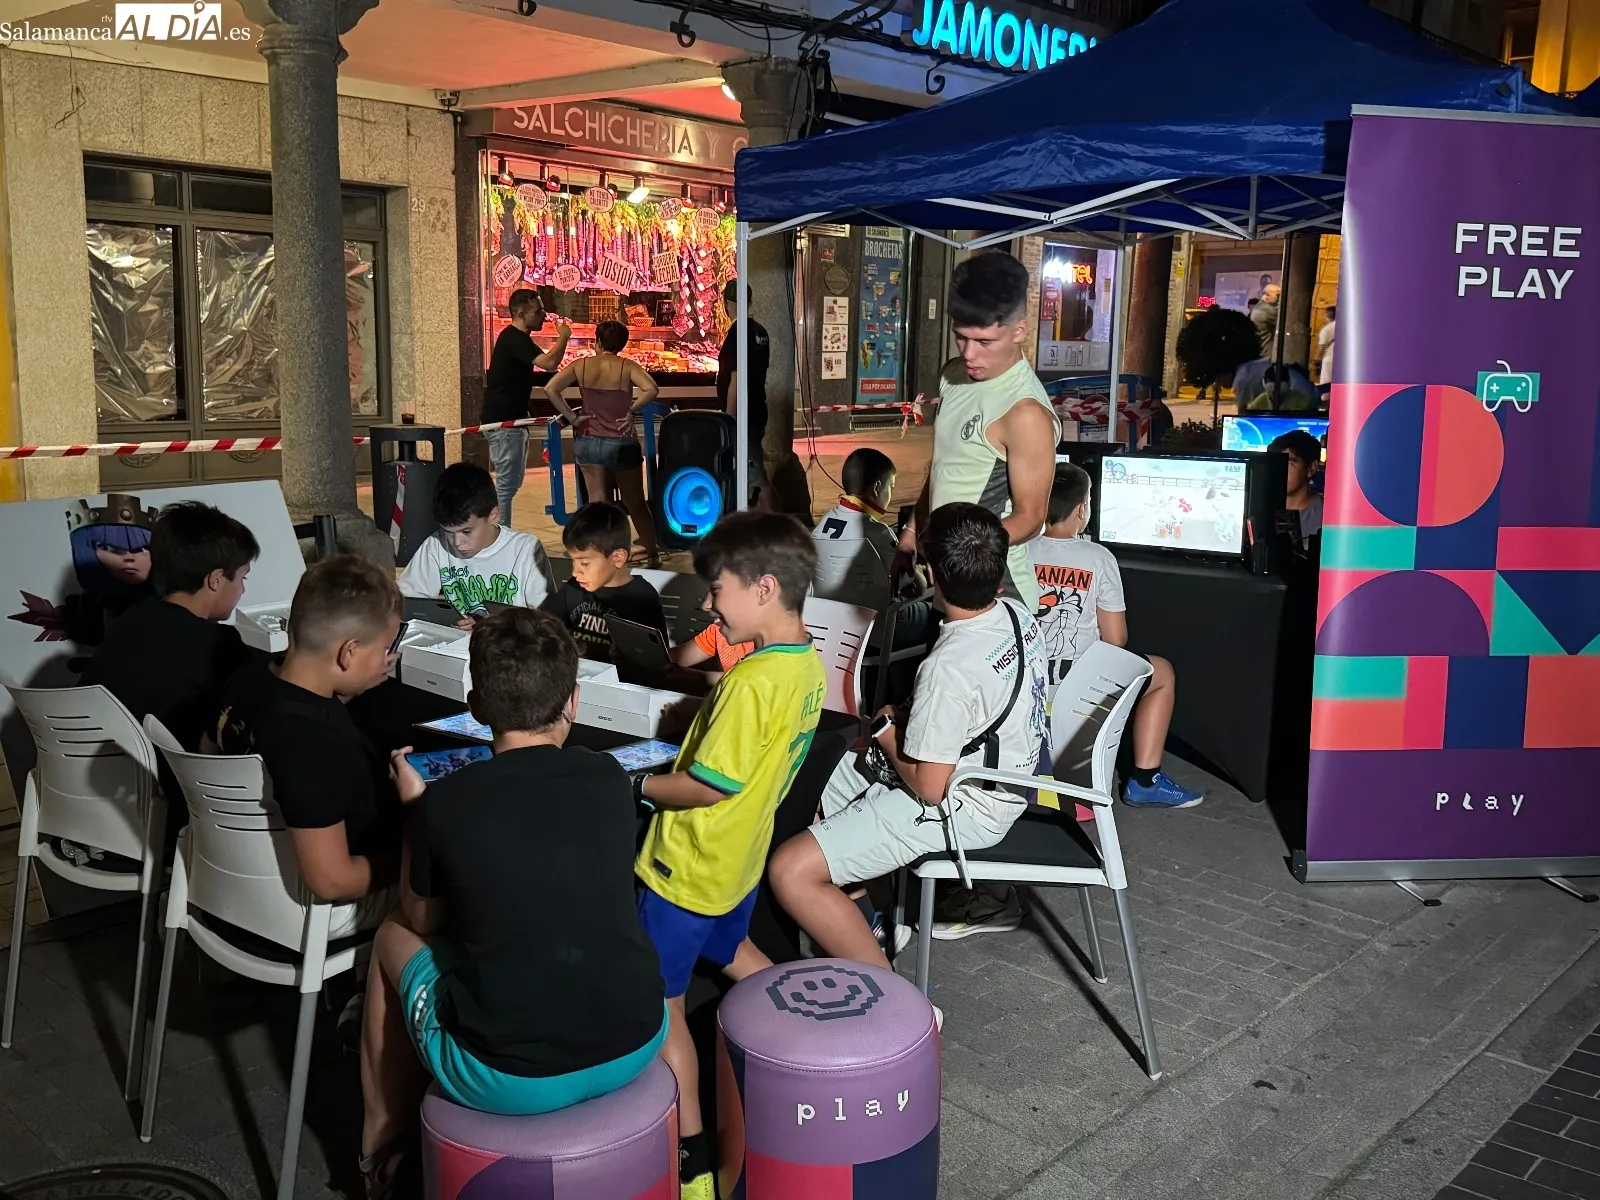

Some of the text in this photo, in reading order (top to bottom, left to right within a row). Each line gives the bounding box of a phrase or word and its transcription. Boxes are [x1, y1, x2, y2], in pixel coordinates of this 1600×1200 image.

[912, 0, 1097, 70] JAMONE
[411, 197, 426, 213] 29
[864, 240, 903, 260] BROCHETAS
[1455, 222, 1582, 258] FREE
[600, 255, 635, 291] TOSTÓN
[656, 264, 680, 285] LECHAL
[1458, 266, 1574, 299] PLAY
[1036, 564, 1092, 590] ANIAN
[992, 643, 1019, 674] MISSIO
[1023, 622, 1038, 646] AILED
[1436, 792, 1524, 817] play
[797, 1089, 909, 1126] play
